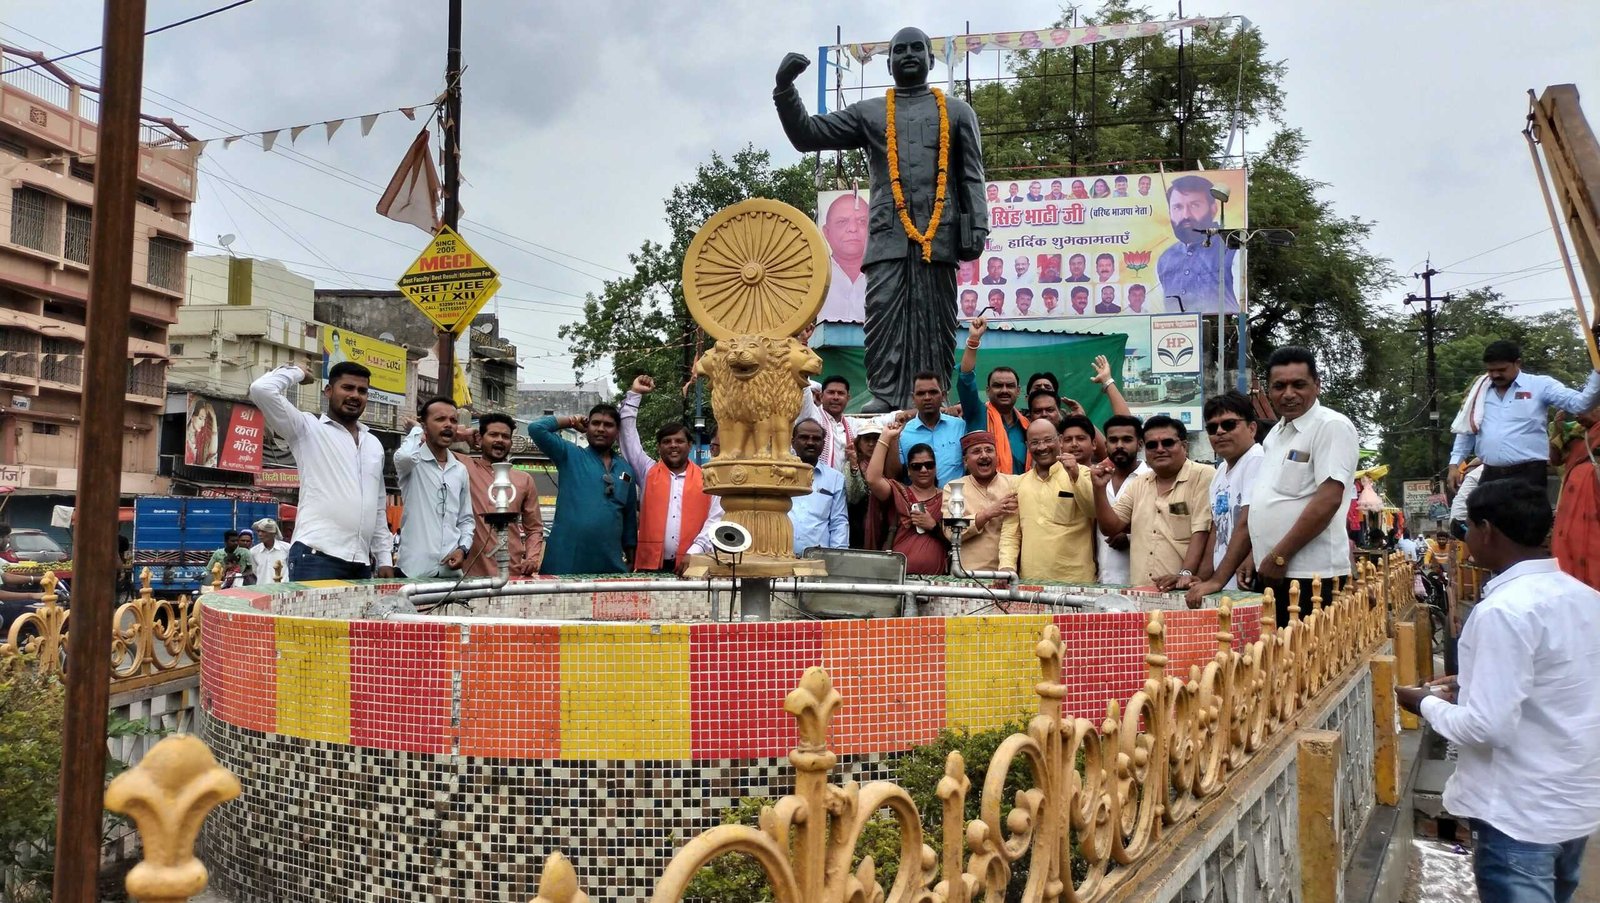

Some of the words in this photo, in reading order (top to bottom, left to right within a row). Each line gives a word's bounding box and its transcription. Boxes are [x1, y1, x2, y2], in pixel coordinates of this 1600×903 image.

[991, 205, 1022, 227] सिंह
[1025, 204, 1058, 226] भाटी
[1062, 203, 1085, 224] जी
[1112, 206, 1133, 217] भाजपा
[1008, 235, 1046, 249] हार्दिक
[1052, 231, 1130, 249] शुभकामनाएँ
[436, 246, 456, 254] 2005
[410, 281, 485, 294] NEET/JEE
[420, 294, 436, 303] XI
[453, 291, 476, 300] XII
[1166, 338, 1186, 348] HP
[234, 424, 258, 437] कला
[233, 438, 258, 453] मंदिर
